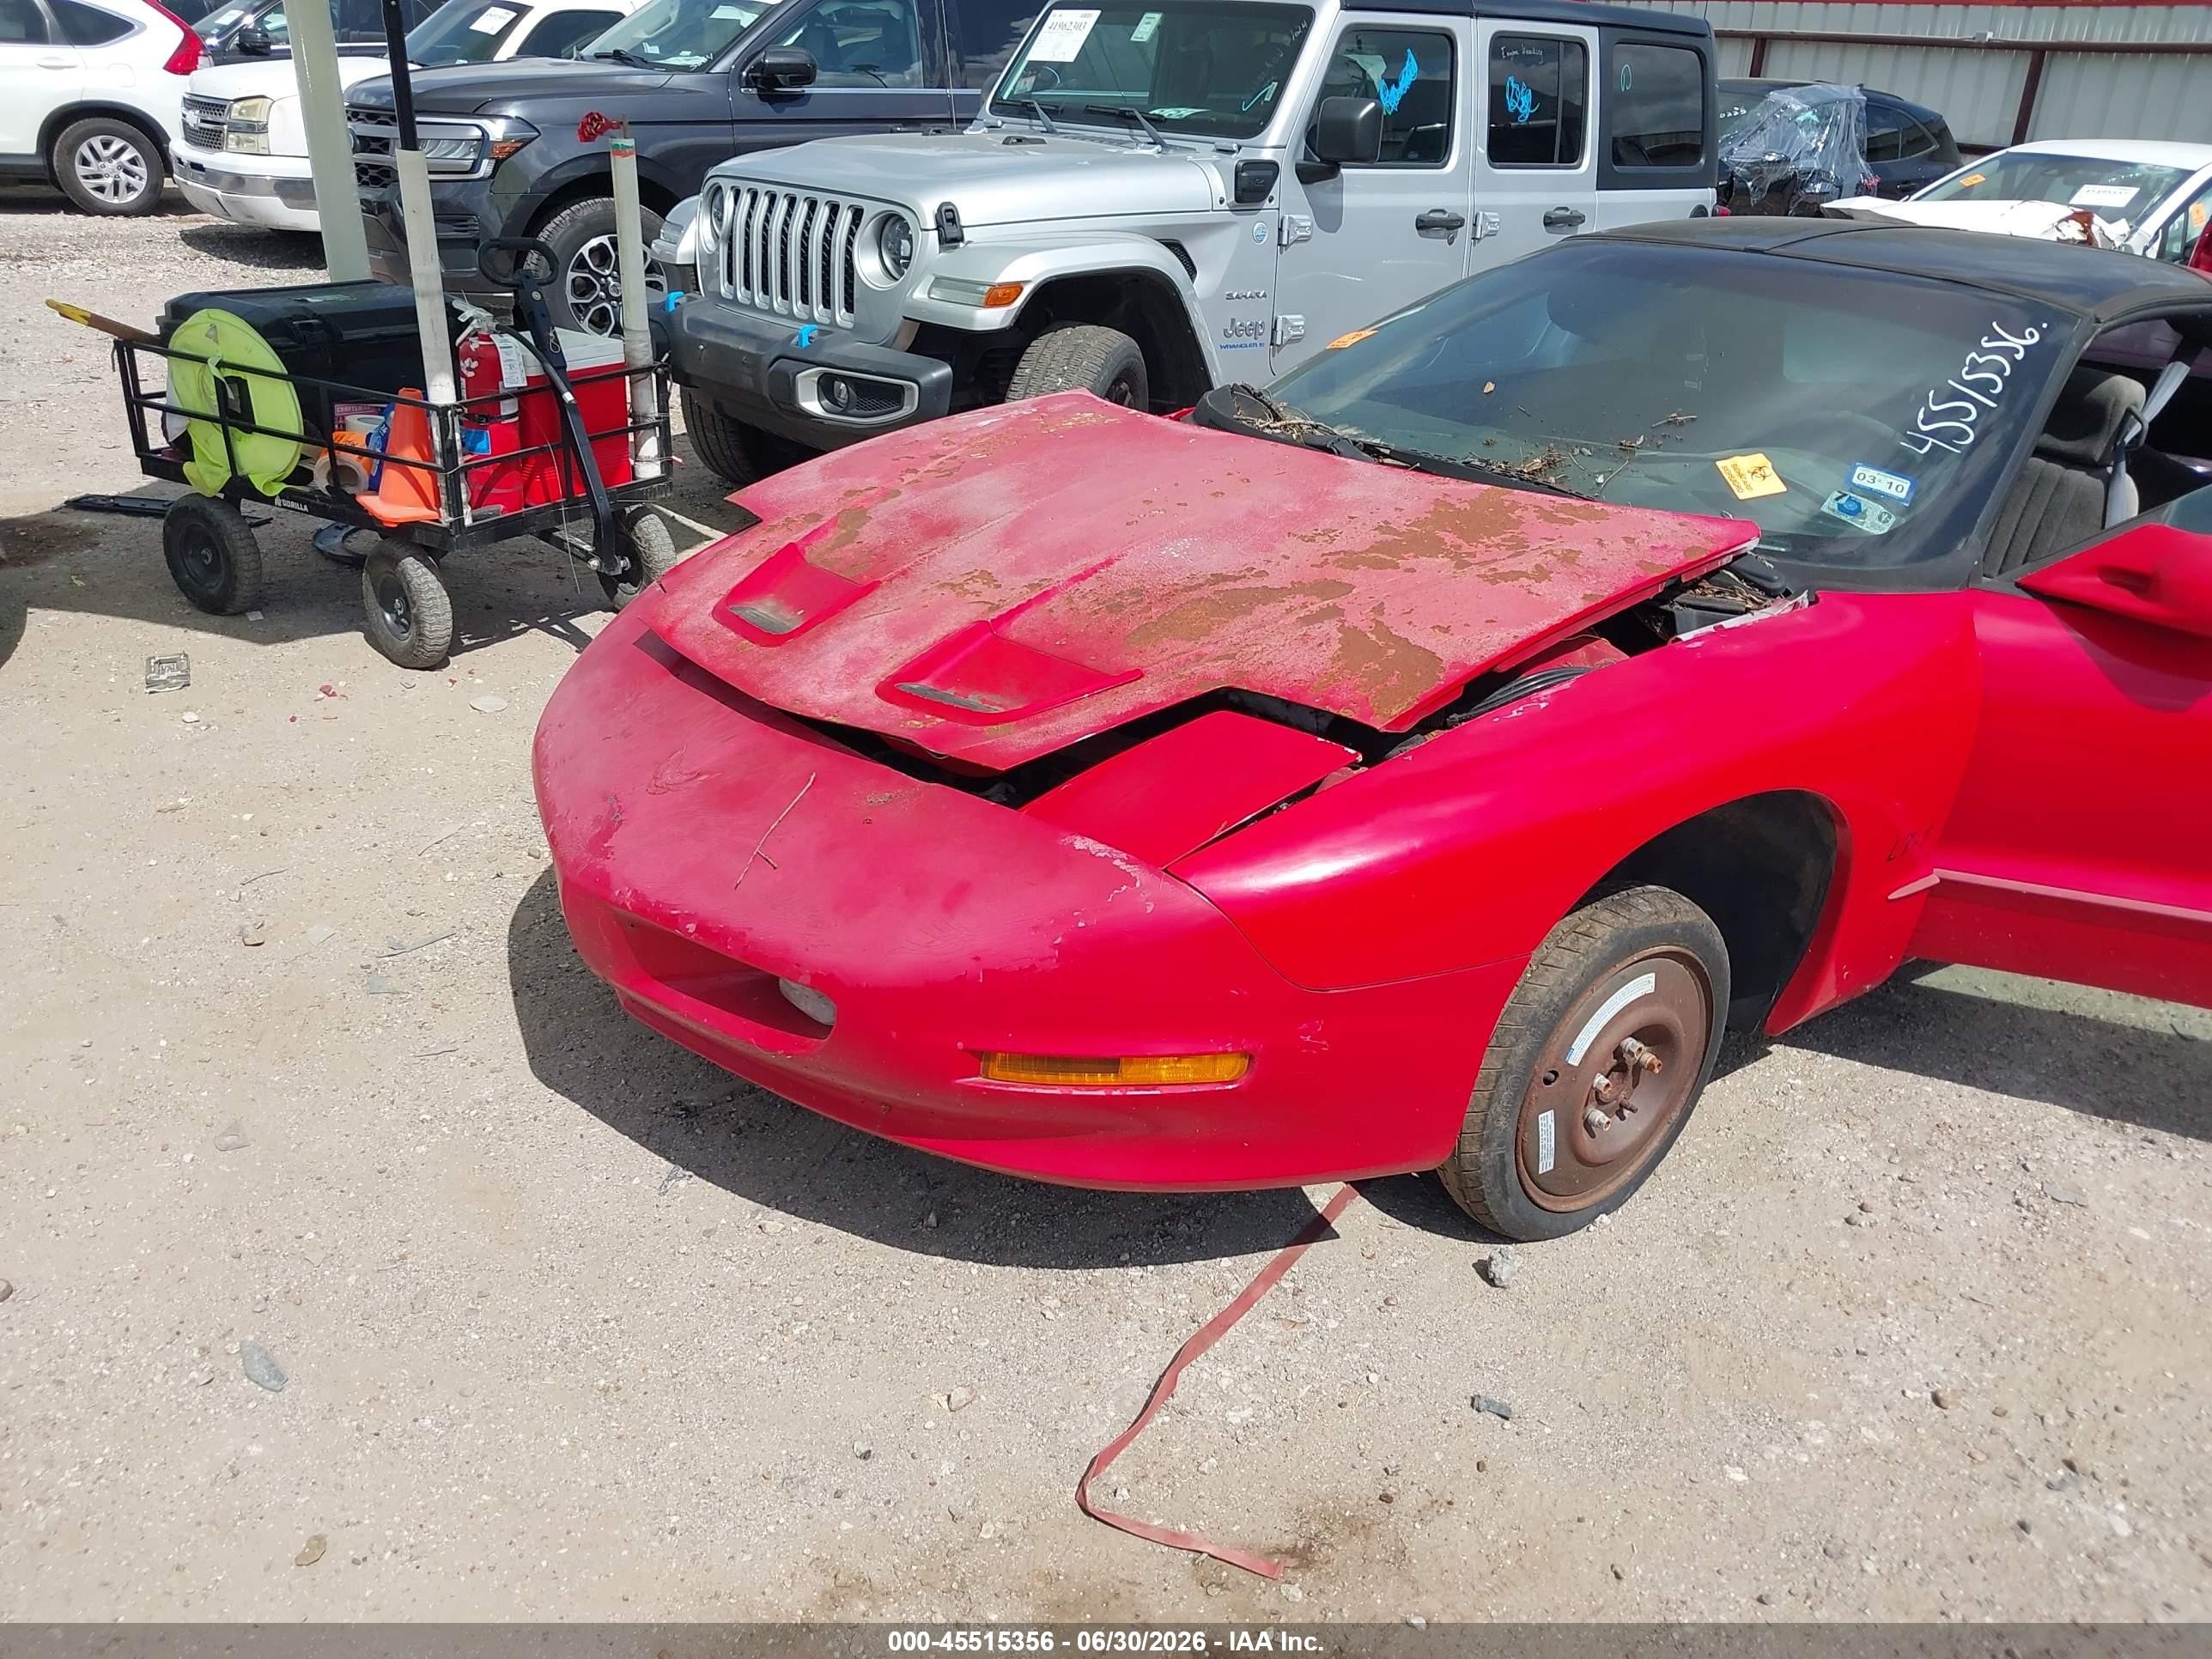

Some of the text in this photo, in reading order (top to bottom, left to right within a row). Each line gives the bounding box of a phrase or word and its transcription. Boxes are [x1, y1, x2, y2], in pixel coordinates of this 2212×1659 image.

[1224, 290, 1267, 301] SAHARA
[1223, 318, 1266, 340] Jeep
[1856, 471, 1876, 484] 03
[1887, 481, 1905, 494] 10
